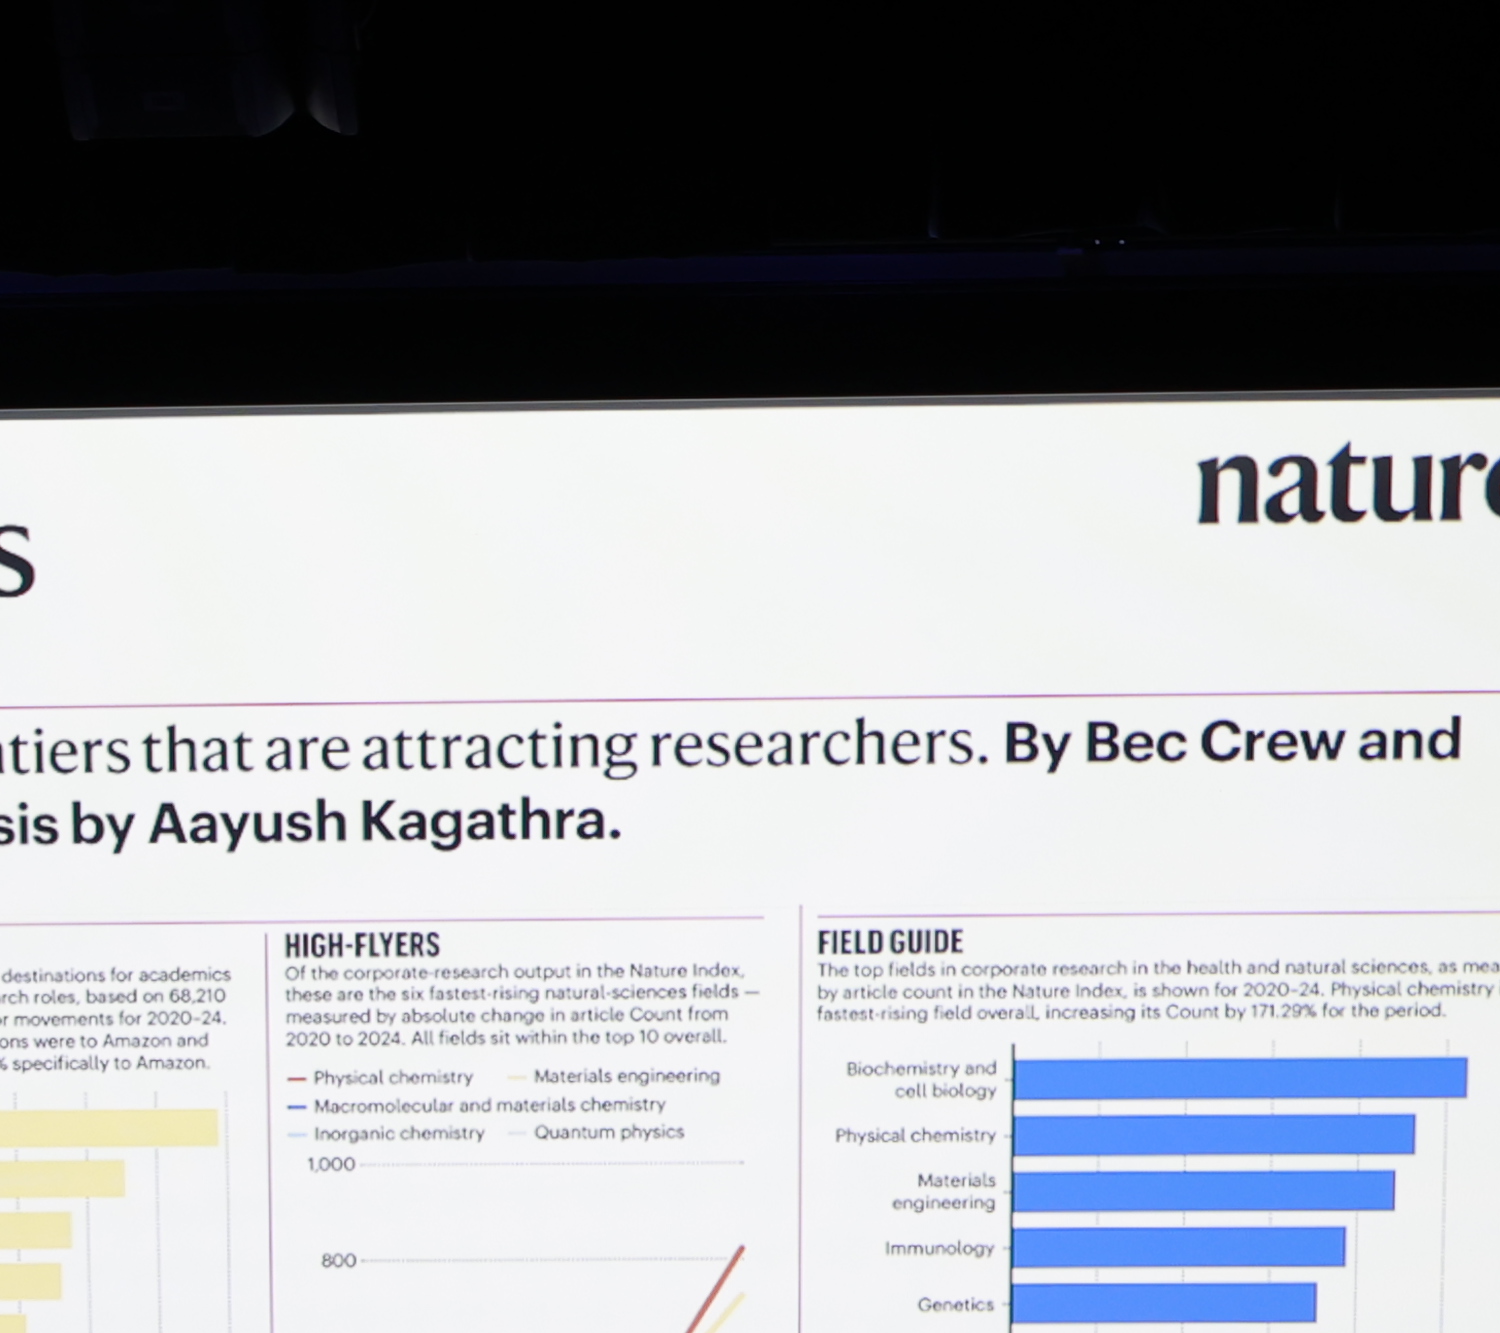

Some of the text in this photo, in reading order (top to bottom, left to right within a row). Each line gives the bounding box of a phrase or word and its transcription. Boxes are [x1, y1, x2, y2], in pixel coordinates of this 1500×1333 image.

[143, 724, 253, 773] that
[266, 736, 349, 772] are
[363, 721, 637, 781] attracting
[652, 716, 987, 767] researchers.
[1007, 721, 1071, 774] By
[1087, 721, 1186, 763] Bec
[1201, 719, 1345, 763] Crew
[1359, 715, 1461, 762] and
[72, 801, 135, 855] by
[149, 798, 346, 852] Aayush
[363, 796, 620, 851] Kagathra.
[286, 931, 439, 958] HIGH-FLYERS
[819, 929, 962, 954] FIELD GUIDE
[1, 968, 106, 985] destinations
[110, 966, 134, 984] for
[138, 965, 232, 984] academics
[286, 1004, 729, 1027] measured by absolute change in article Count from
[816, 1001, 1446, 1025] fastest-rising field overall, increasing its Count by 171.29% for the period.
[313, 1068, 474, 1089] Physical chemistry
[534, 1066, 721, 1088] Materials engineering
[846, 1059, 998, 1079] Biochemistry and
[894, 1081, 997, 1102] cell biology
[314, 1095, 666, 1115] Macromolecular and materials chemistry
[885, 1239, 995, 1260] Immunology
[917, 1296, 995, 1313] Genetics
